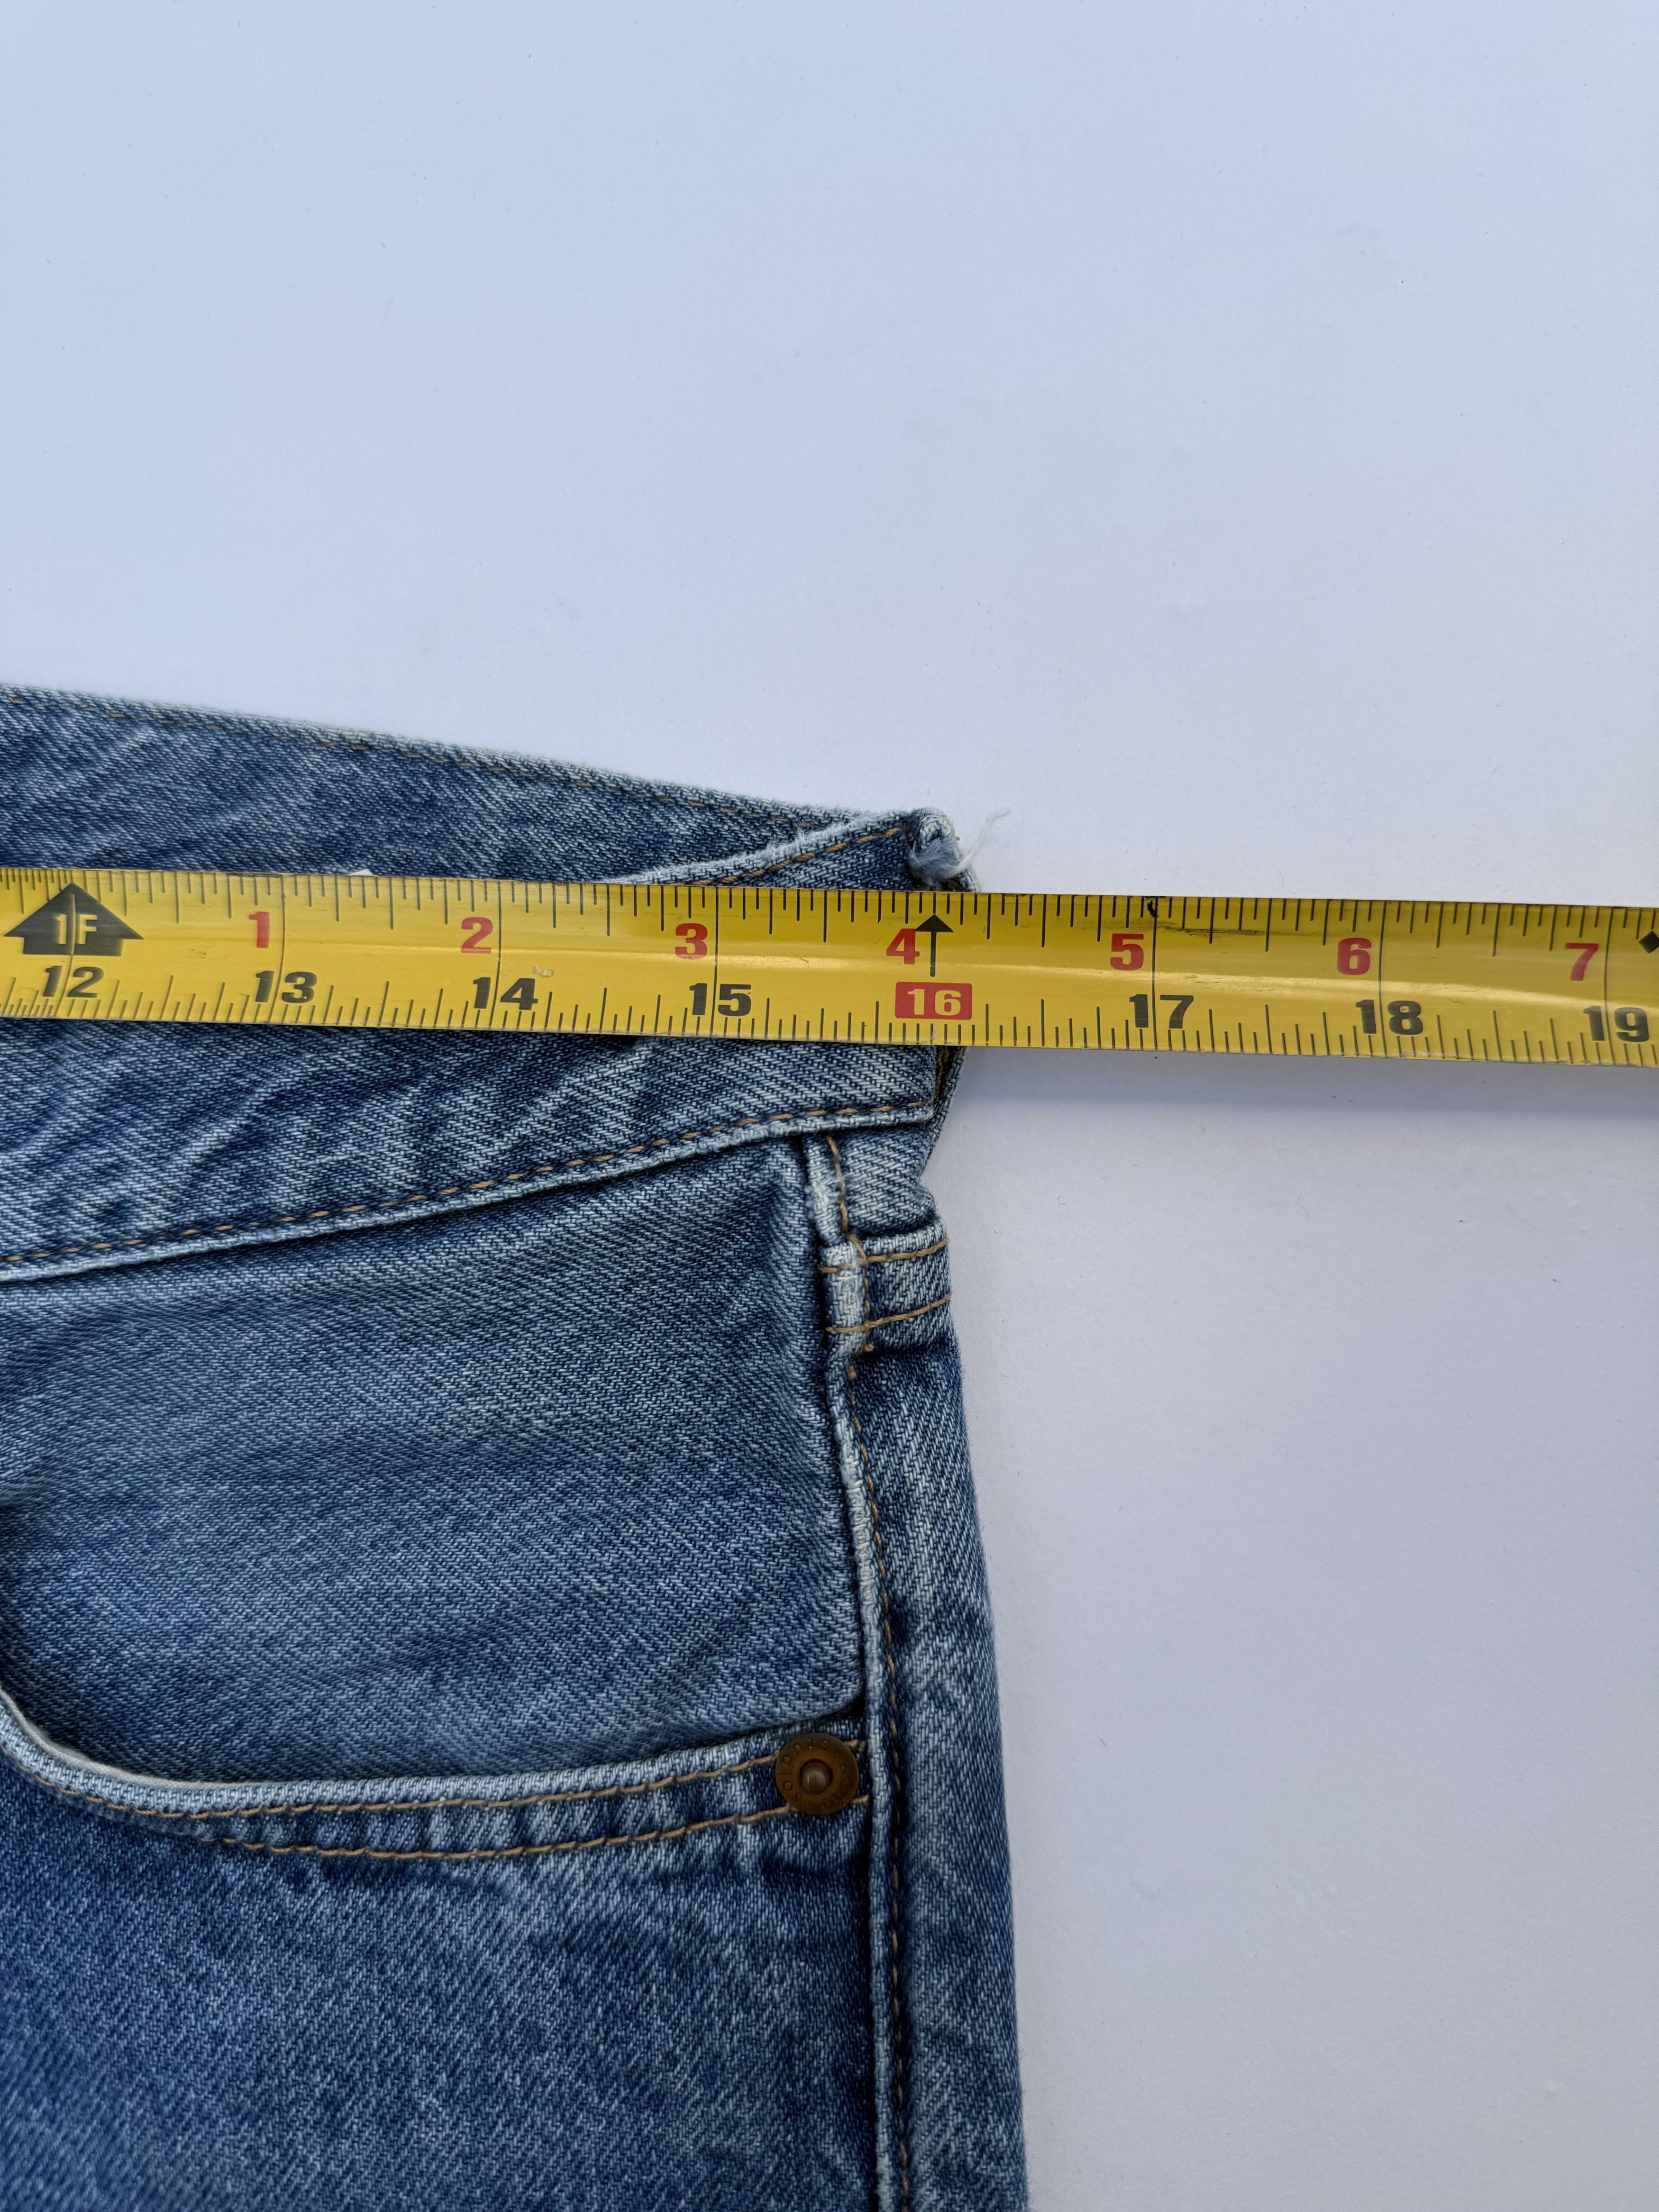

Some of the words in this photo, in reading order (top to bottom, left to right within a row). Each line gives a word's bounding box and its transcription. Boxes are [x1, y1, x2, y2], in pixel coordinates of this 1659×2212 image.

[56, 914, 97, 945] 1F
[249, 911, 270, 948] 1
[461, 917, 493, 954] 2
[675, 923, 708, 960] 3
[886, 928, 920, 965] 4
[1110, 934, 1144, 971] 5
[1336, 938, 1371, 975] 6
[1565, 942, 1599, 981] 7
[43, 965, 104, 998] 12
[255, 970, 317, 1003] 13
[473, 977, 538, 1010] 14
[689, 983, 752, 1016] 15
[908, 988, 961, 1016] 16
[1129, 994, 1194, 1029] 17
[1355, 999, 1423, 1035] 18
[1583, 1005, 1649, 1042] 19
